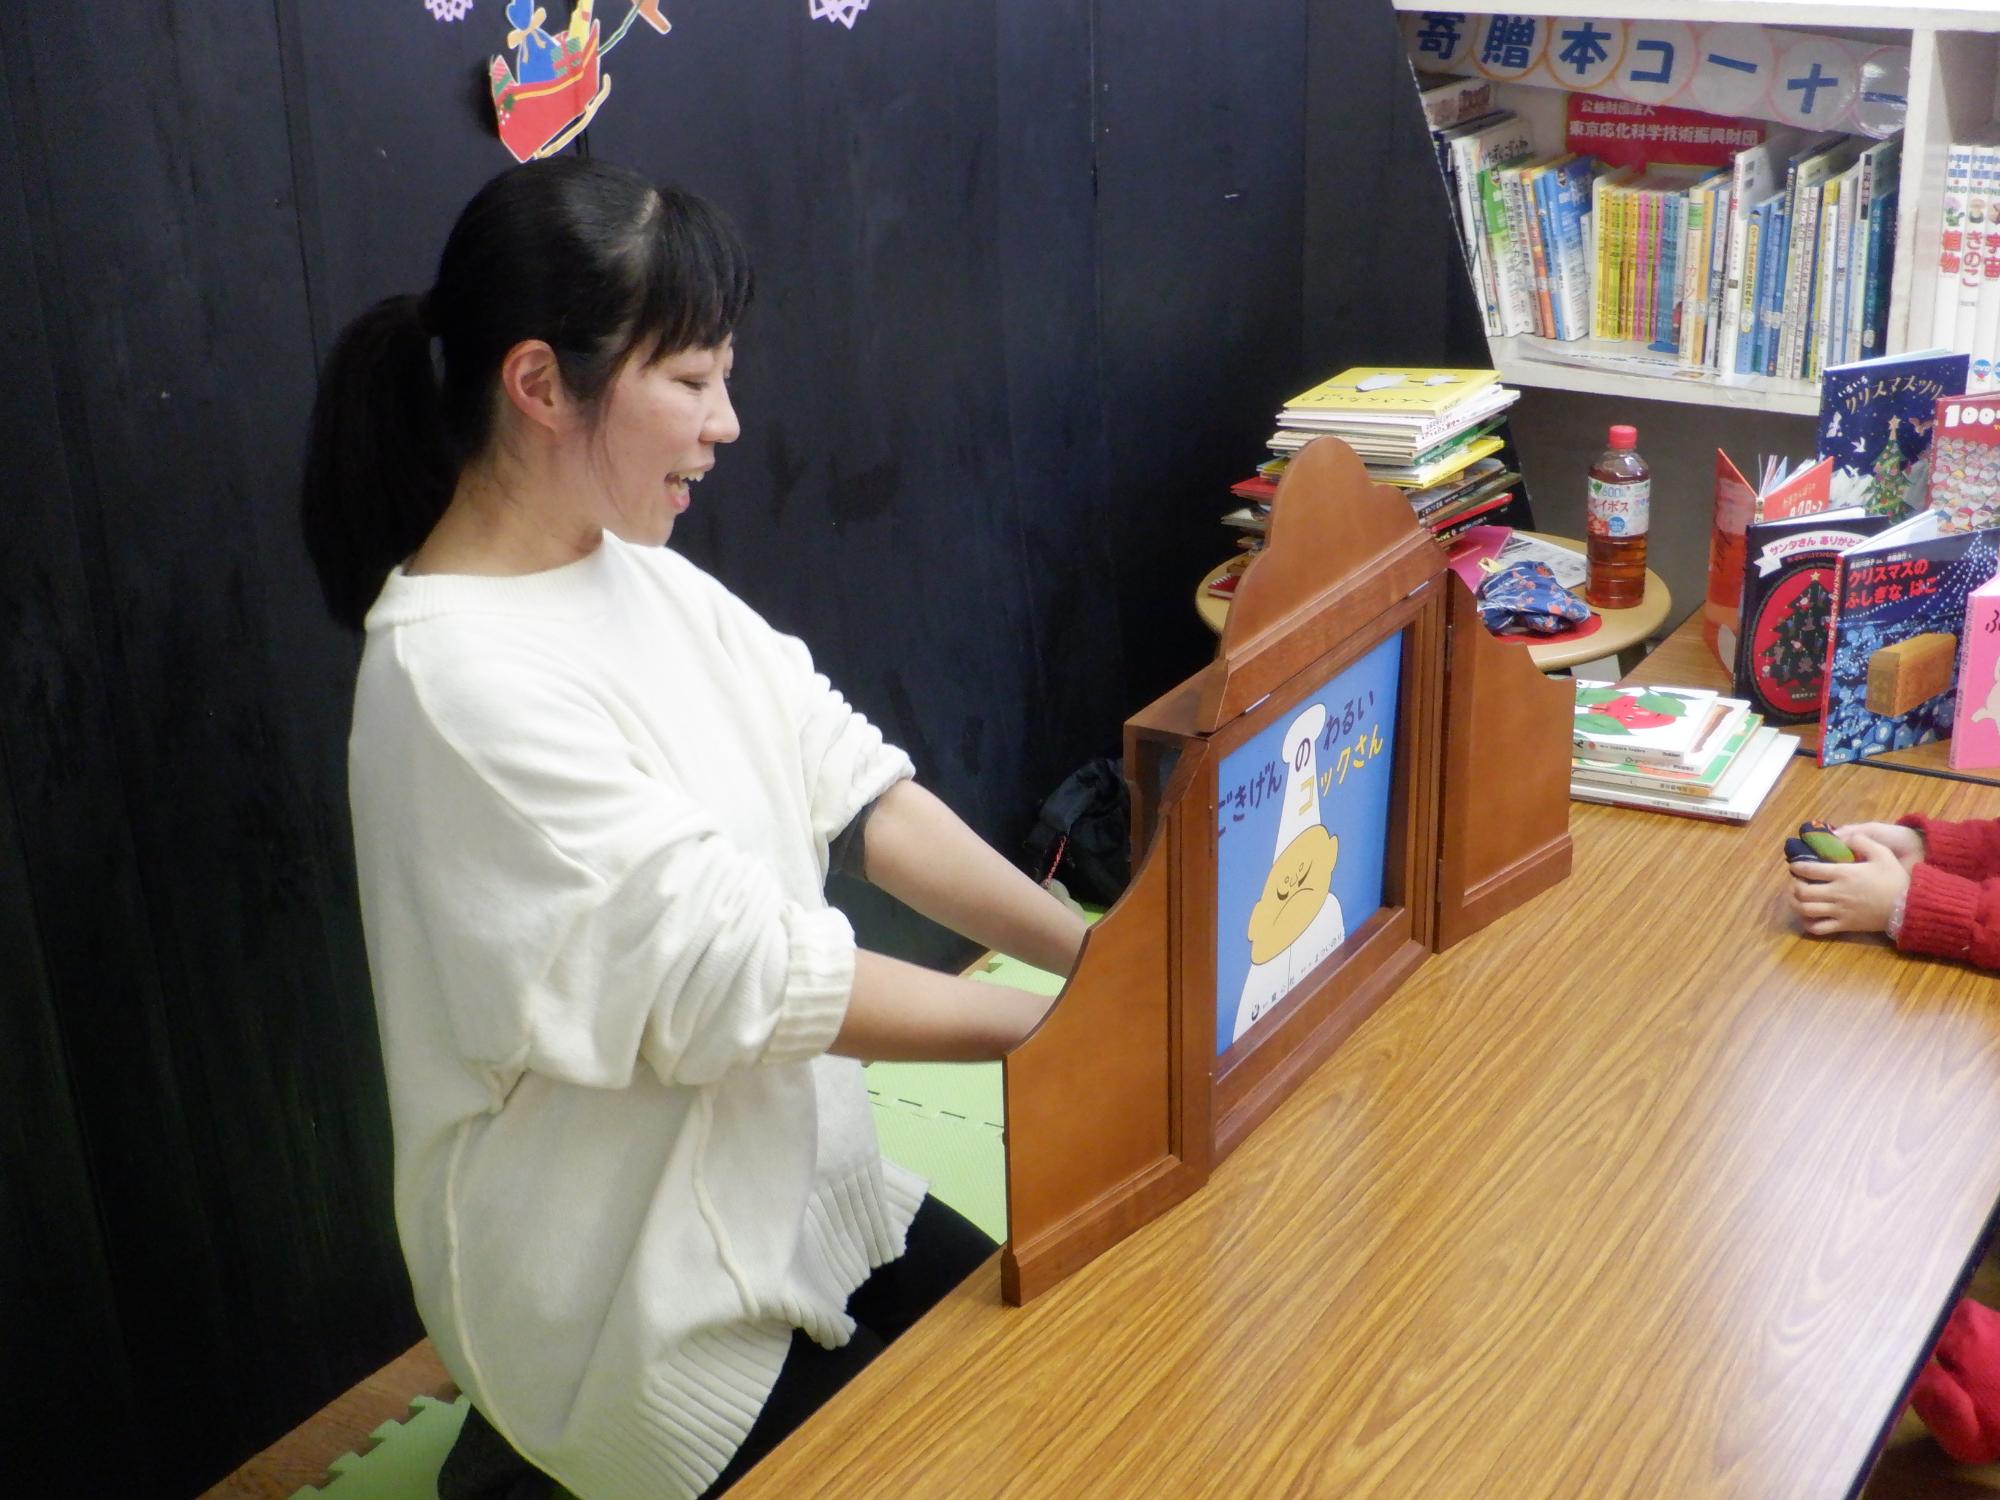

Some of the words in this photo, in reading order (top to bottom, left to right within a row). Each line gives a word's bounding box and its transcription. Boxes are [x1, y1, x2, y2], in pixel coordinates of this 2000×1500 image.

[1416, 12, 1908, 115] 寄贈本コーナー
[1569, 120, 1759, 146] 東京応化科学技術振興財団
[1941, 229, 1962, 274] 植物
[1962, 231, 1983, 287] きのこ
[1845, 375, 1947, 415] クリスマスツリ
[1945, 404, 2000, 428] 100
[1769, 536, 1816, 555] サンタさん
[1848, 558, 1928, 589] クリスマスの
[1845, 584, 1903, 609] ふしぎな
[1909, 579, 1937, 597] はこ
[1299, 723, 1383, 816] コックさん
